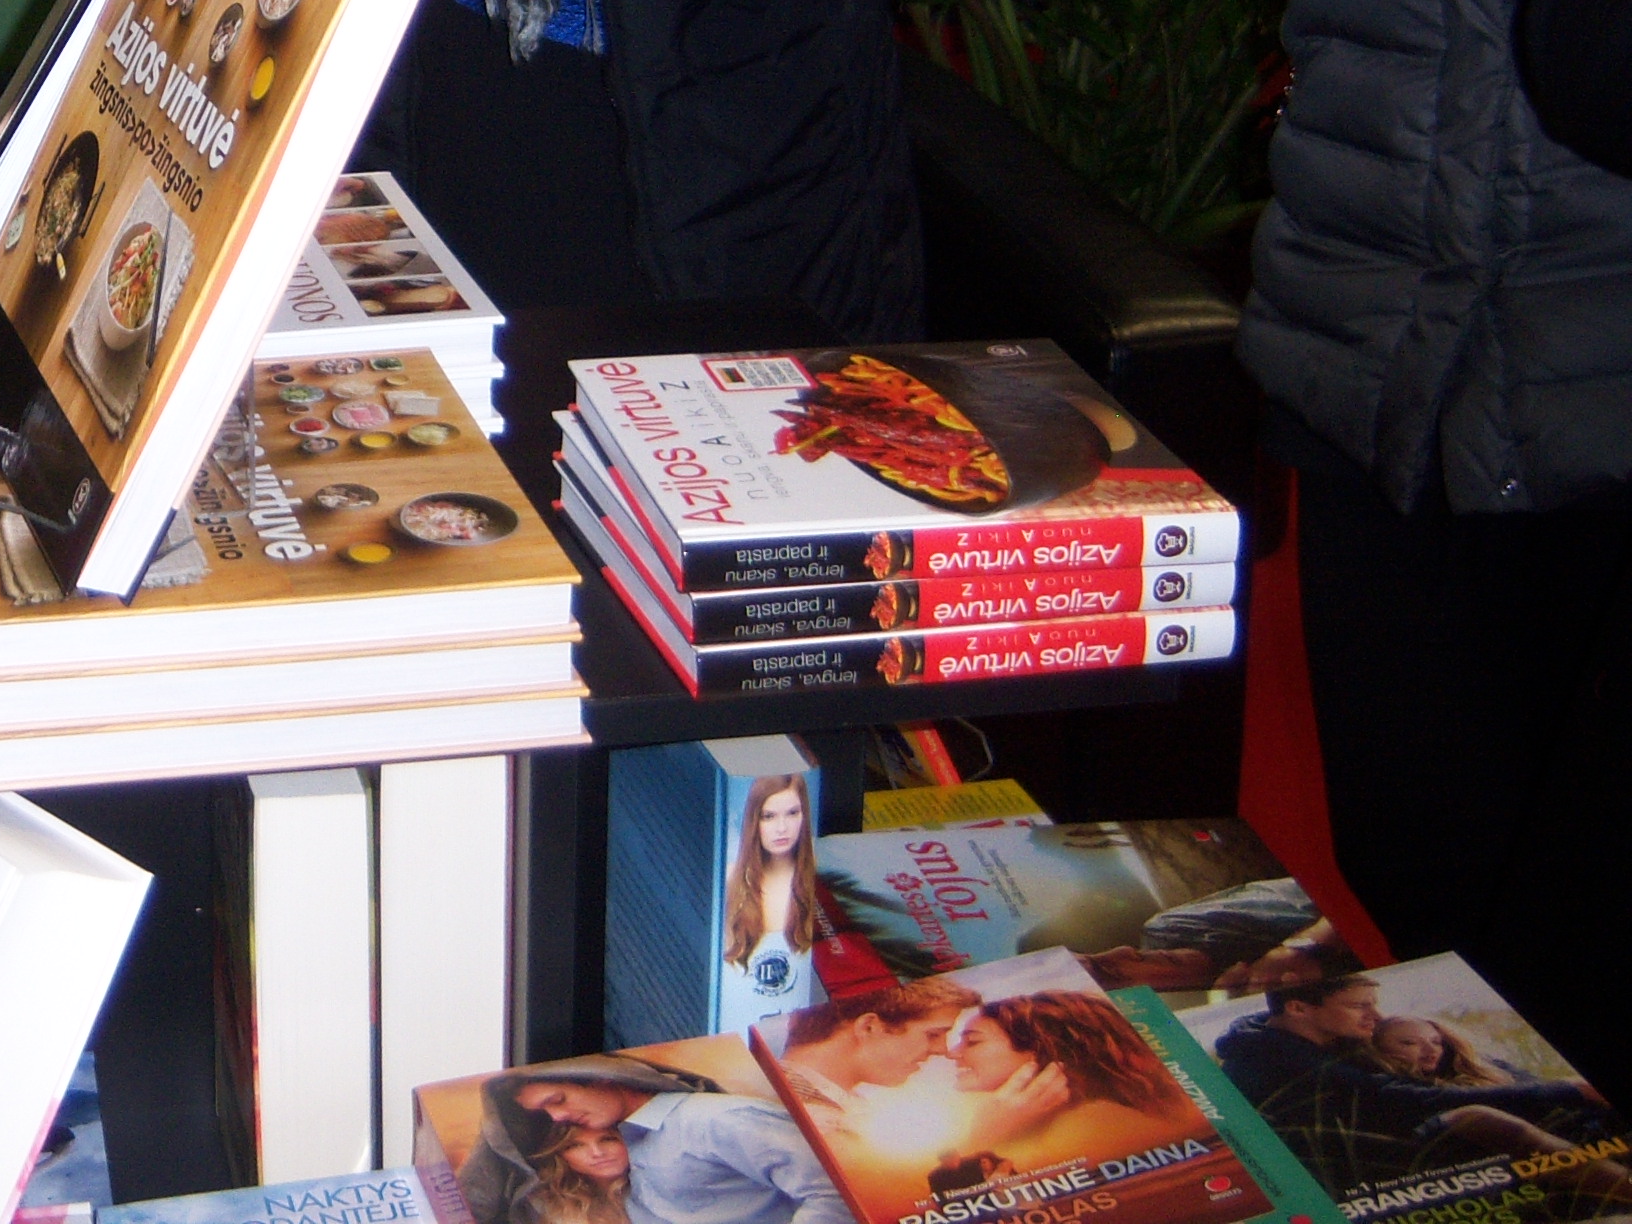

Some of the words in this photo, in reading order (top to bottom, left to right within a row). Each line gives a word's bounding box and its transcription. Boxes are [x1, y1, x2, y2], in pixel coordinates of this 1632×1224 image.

[105, 0, 168, 96] Azijos
[158, 62, 241, 169] virtuvė
[659, 379, 691, 392] Z
[584, 361, 680, 443] virtuvė
[700, 435, 733, 447] A
[652, 446, 745, 526] Azijos
[957, 533, 969, 546] Z
[1021, 528, 1035, 544] A
[735, 542, 813, 566] paprasta
[816, 544, 829, 561] ir
[1034, 539, 1122, 567] Azijos
[783, 561, 846, 578] lengva,
[928, 549, 1026, 575] virtuvė
[724, 567, 778, 583] skanu
[961, 582, 974, 597] Z
[1023, 577, 1037, 592] A
[744, 596, 821, 620] paprasta
[824, 597, 837, 614] ir
[1035, 587, 1122, 614] Azijos
[933, 596, 1029, 625] virtuvė
[733, 621, 786, 638] skanu
[792, 615, 852, 632] lengva,
[966, 636, 979, 651] Z
[1028, 631, 1042, 646] A
[751, 649, 828, 674] paprasta
[830, 651, 843, 669] ir
[1040, 641, 1126, 668] Azijos
[939, 650, 1033, 679] virtuvė
[740, 675, 793, 691] skanu
[798, 668, 858, 685] lengva,
[904, 840, 990, 922] rojus
[898, 1166, 1097, 1224] PASKUTINĖ
[1097, 1137, 1211, 1181] DAINA
[262, 1179, 413, 1216] NAKTYS
[1336, 1165, 1513, 1220] BRANGUSIS
